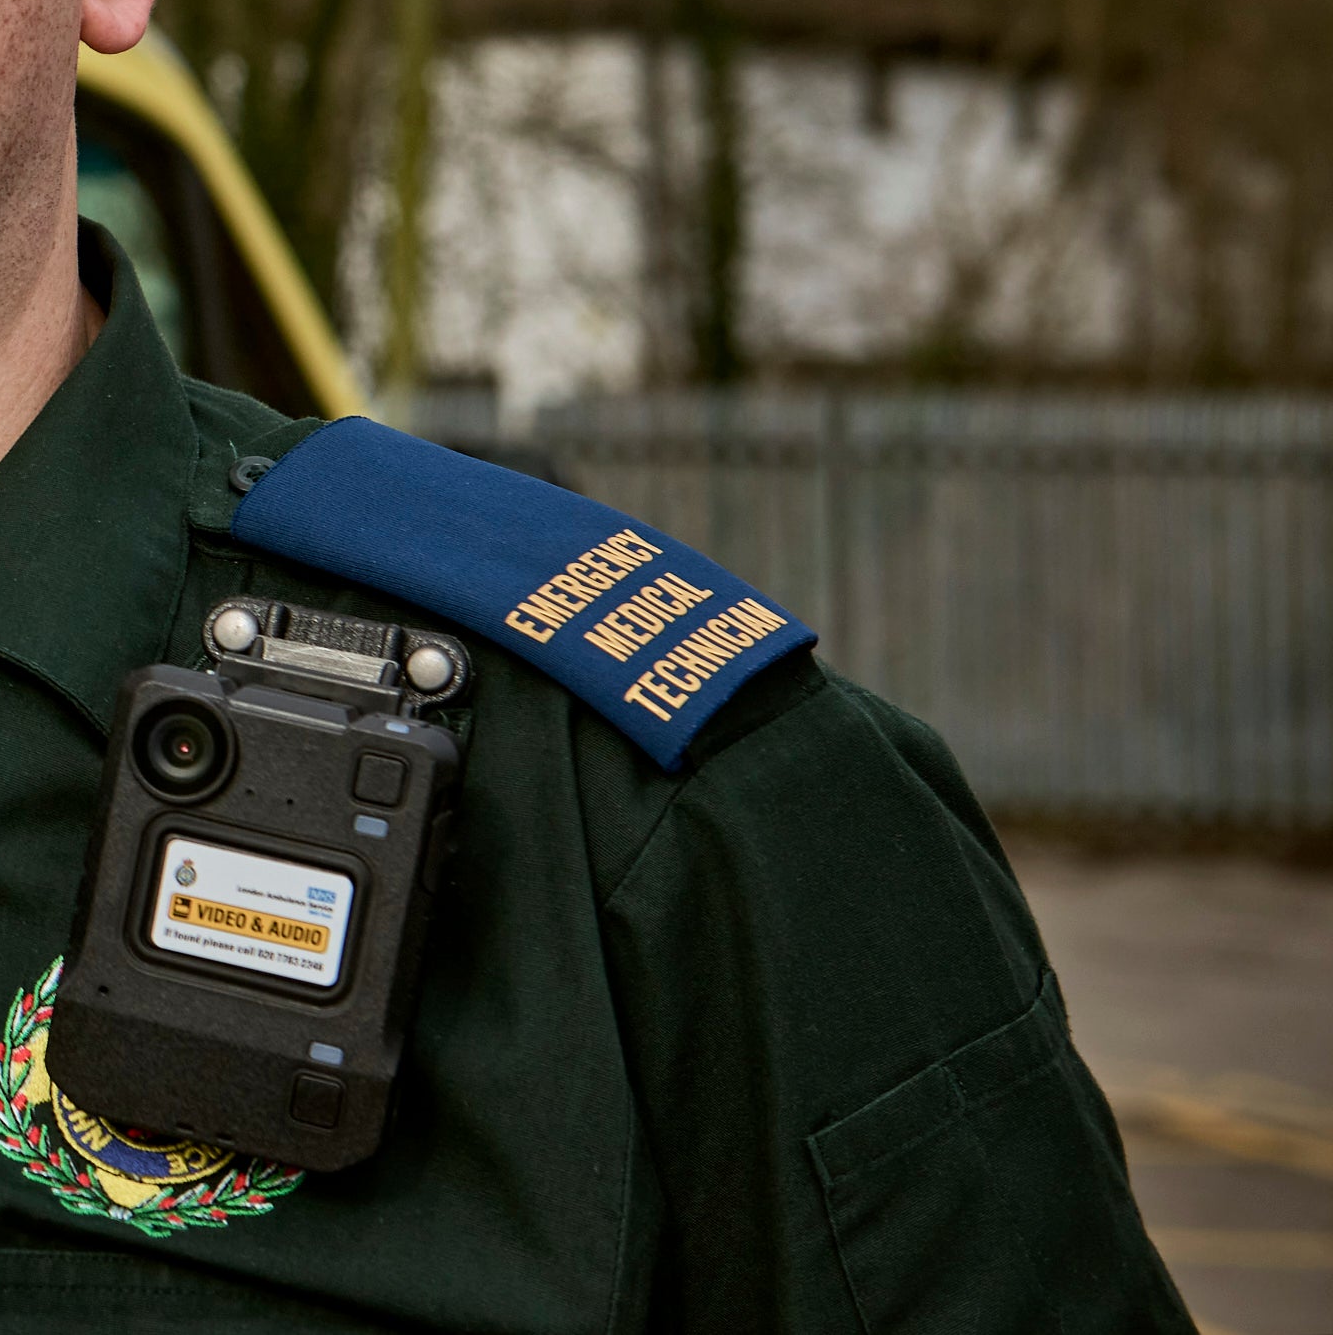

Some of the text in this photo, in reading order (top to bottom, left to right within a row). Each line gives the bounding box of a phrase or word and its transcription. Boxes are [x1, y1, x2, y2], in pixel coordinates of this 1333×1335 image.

[504, 528, 664, 645] EMERGENCY
[583, 572, 714, 663] MEDICAL
[624, 597, 790, 722] TECHNICIAN
[197, 904, 322, 946] VIDEO & AUDIO
